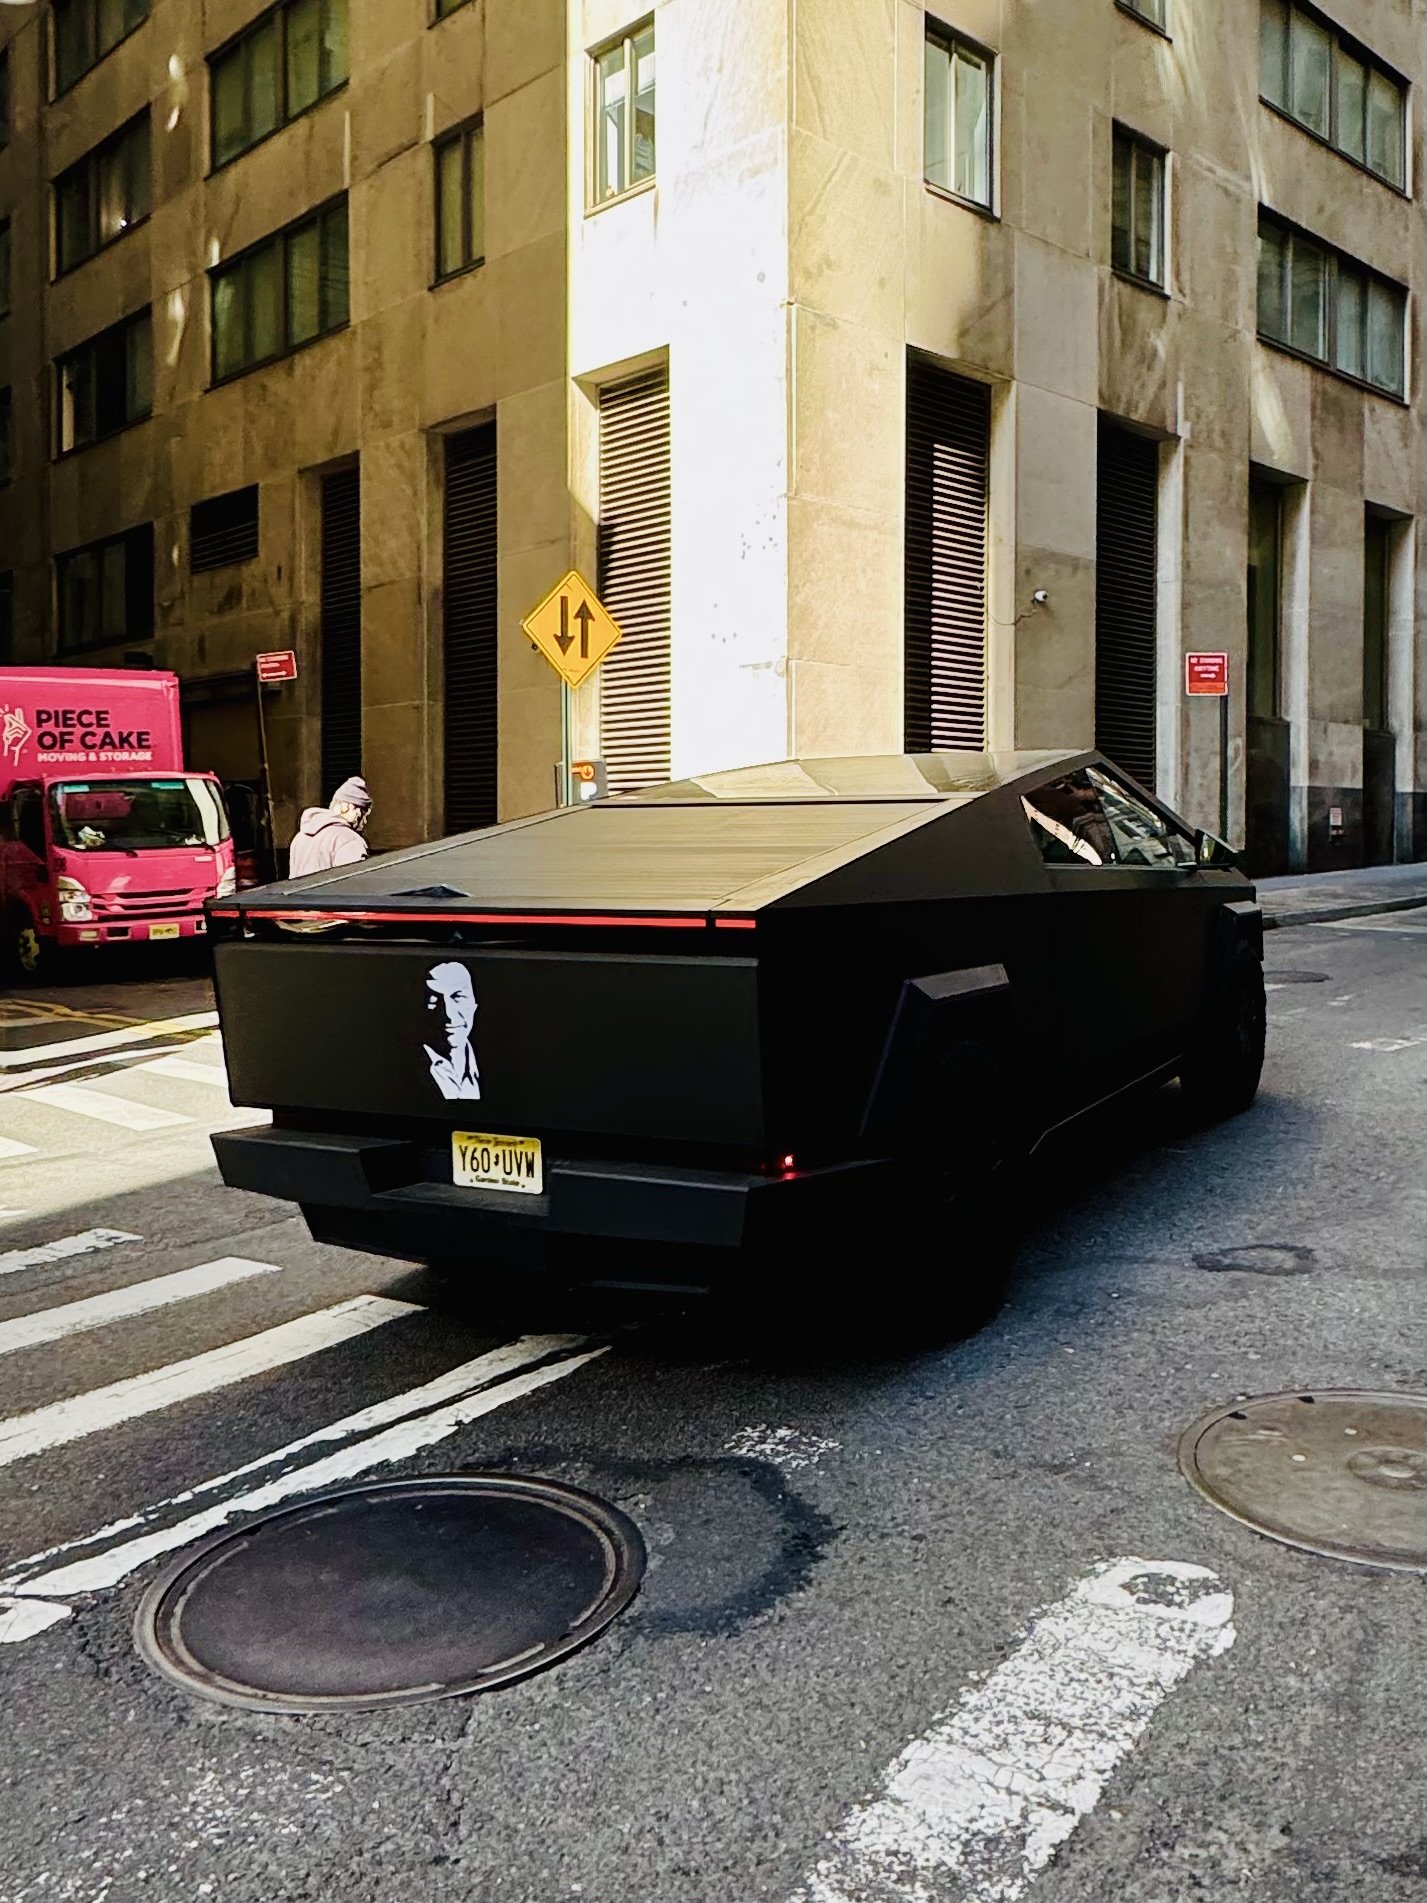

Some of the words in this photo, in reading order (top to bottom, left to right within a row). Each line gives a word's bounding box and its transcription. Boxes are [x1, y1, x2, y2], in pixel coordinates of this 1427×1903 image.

[36, 709, 110, 728] PIECE
[37, 731, 74, 750] OF
[80, 731, 151, 750] CAKE
[37, 752, 87, 762] MOVING
[88, 752, 97, 761] &
[99, 751, 152, 761] STORAGE
